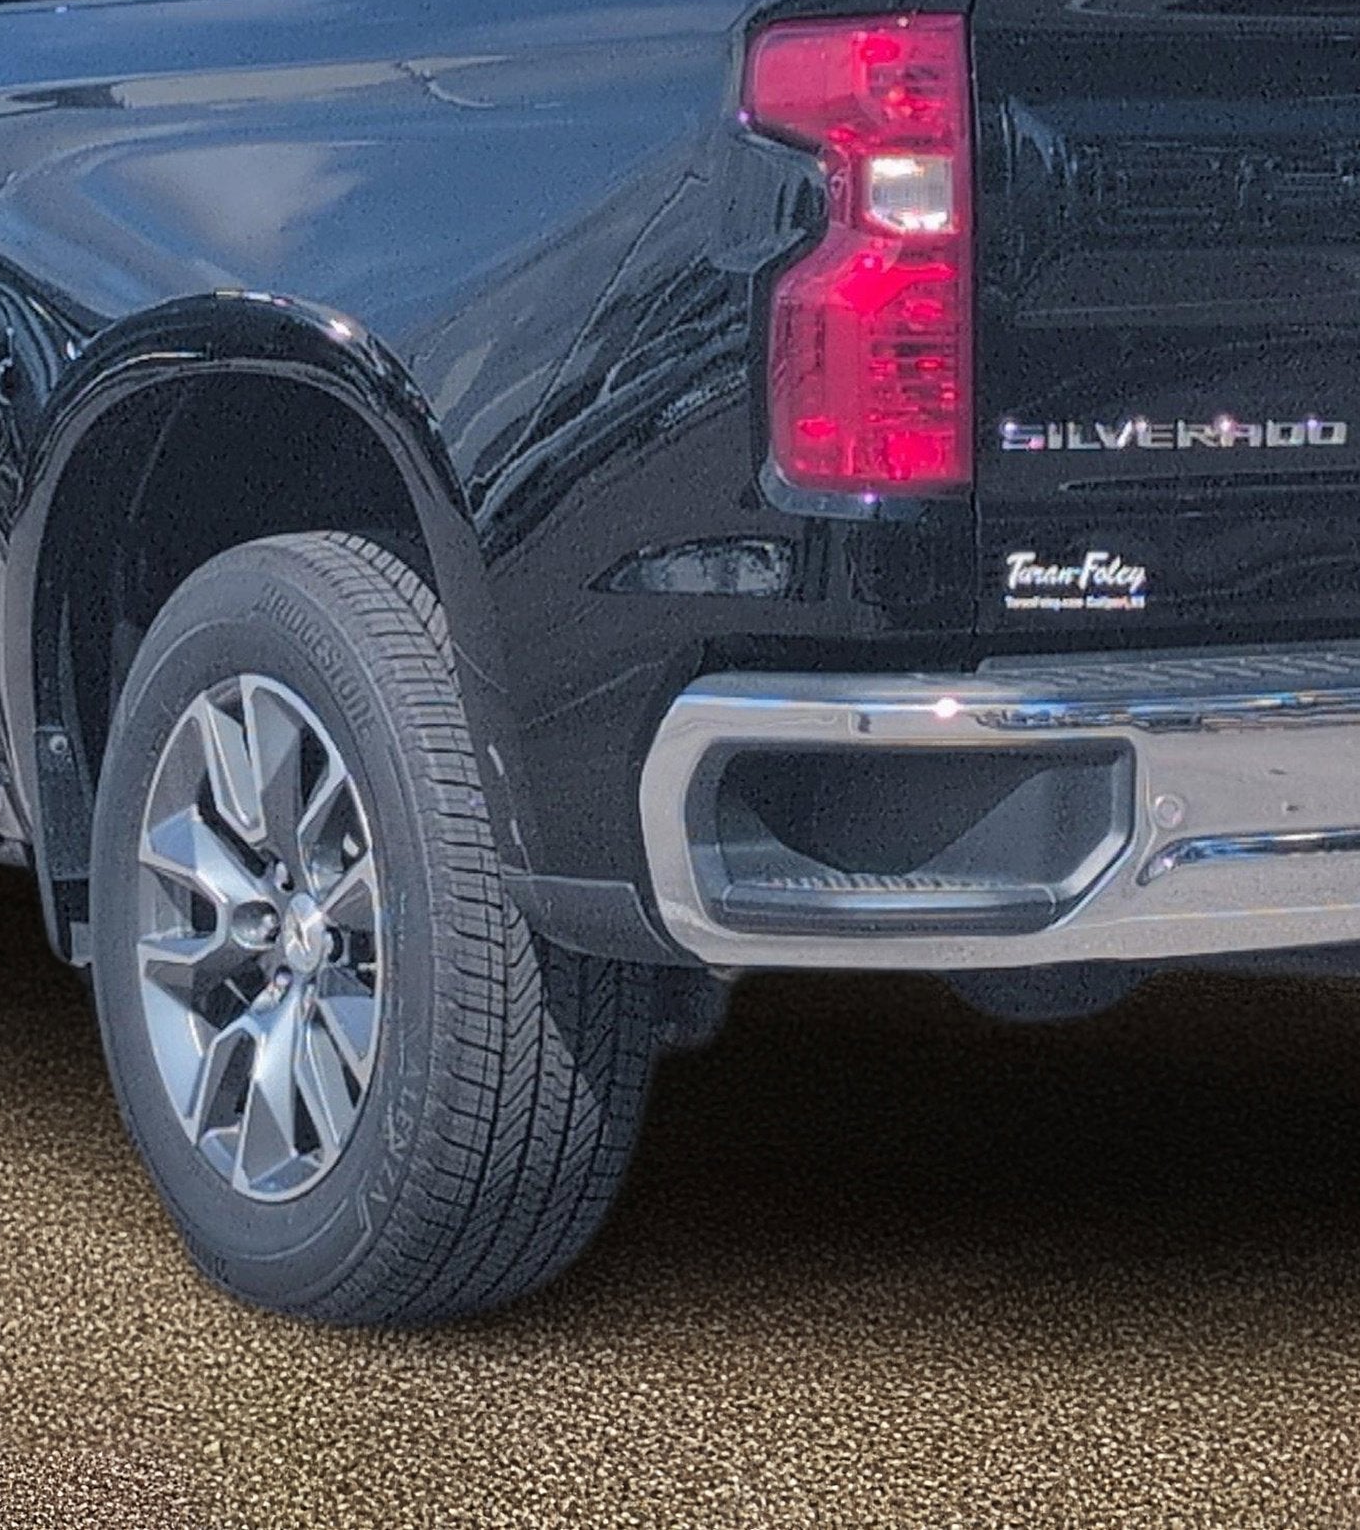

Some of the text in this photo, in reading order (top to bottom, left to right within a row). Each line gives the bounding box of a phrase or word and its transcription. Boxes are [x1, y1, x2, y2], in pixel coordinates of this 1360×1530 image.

[1001, 419, 1347, 450] SILVERADO
[1079, 551, 1146, 594] Foley
[251, 581, 377, 744] BRIDGESTONE
